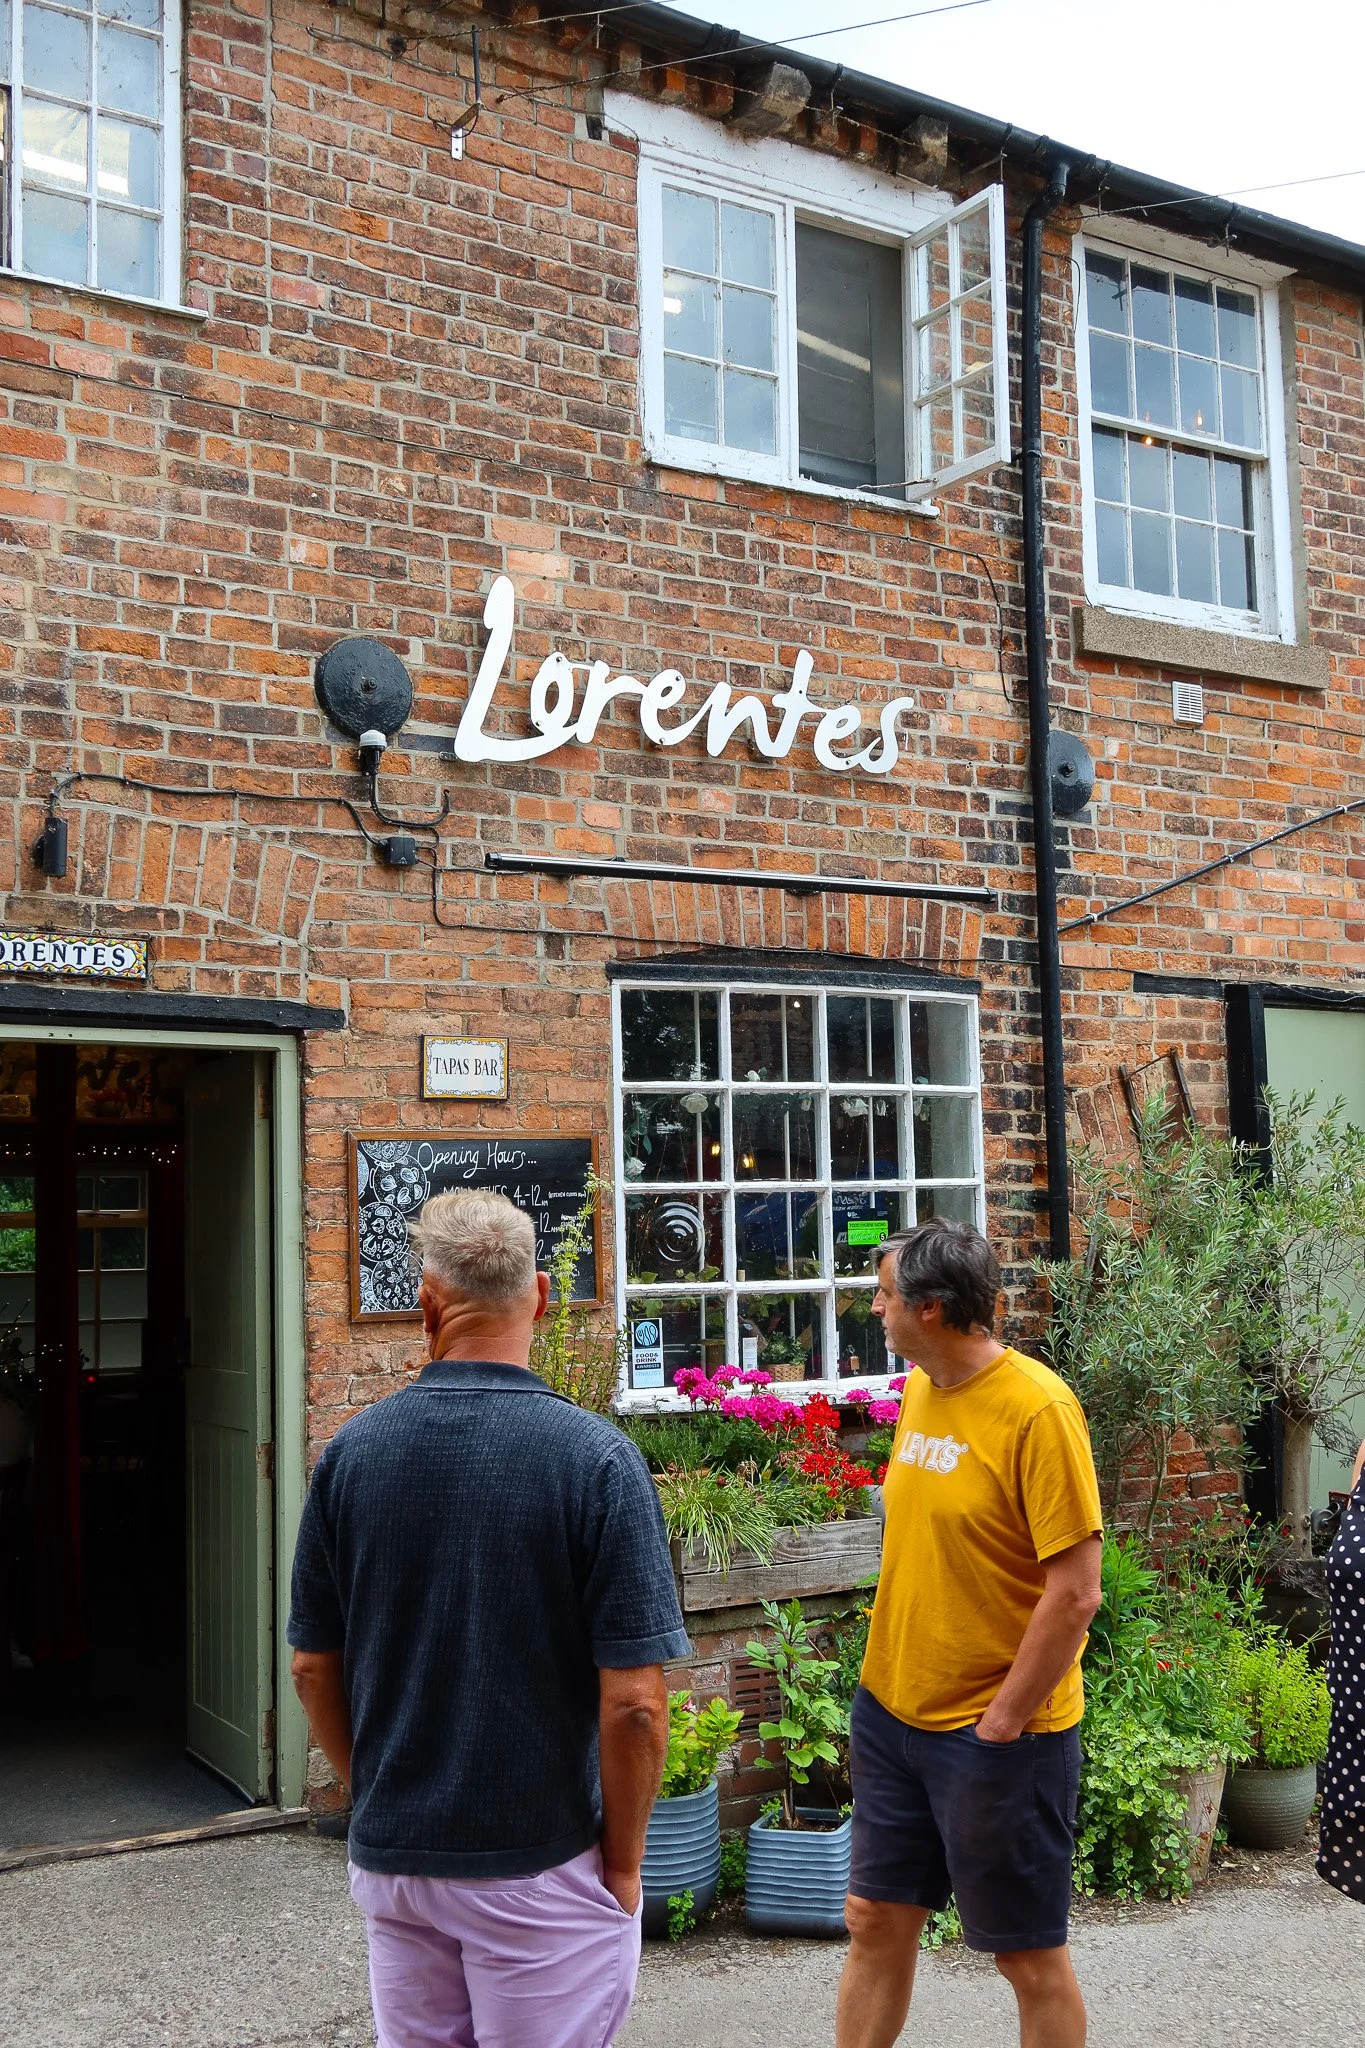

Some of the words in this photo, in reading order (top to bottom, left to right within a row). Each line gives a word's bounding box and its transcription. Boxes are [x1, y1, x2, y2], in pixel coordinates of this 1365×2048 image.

[454, 576, 915, 774] Lorentes
[433, 1057, 470, 1075] TAPAS
[474, 1058, 498, 1076] BAR
[417, 1142, 487, 1178] Opening
